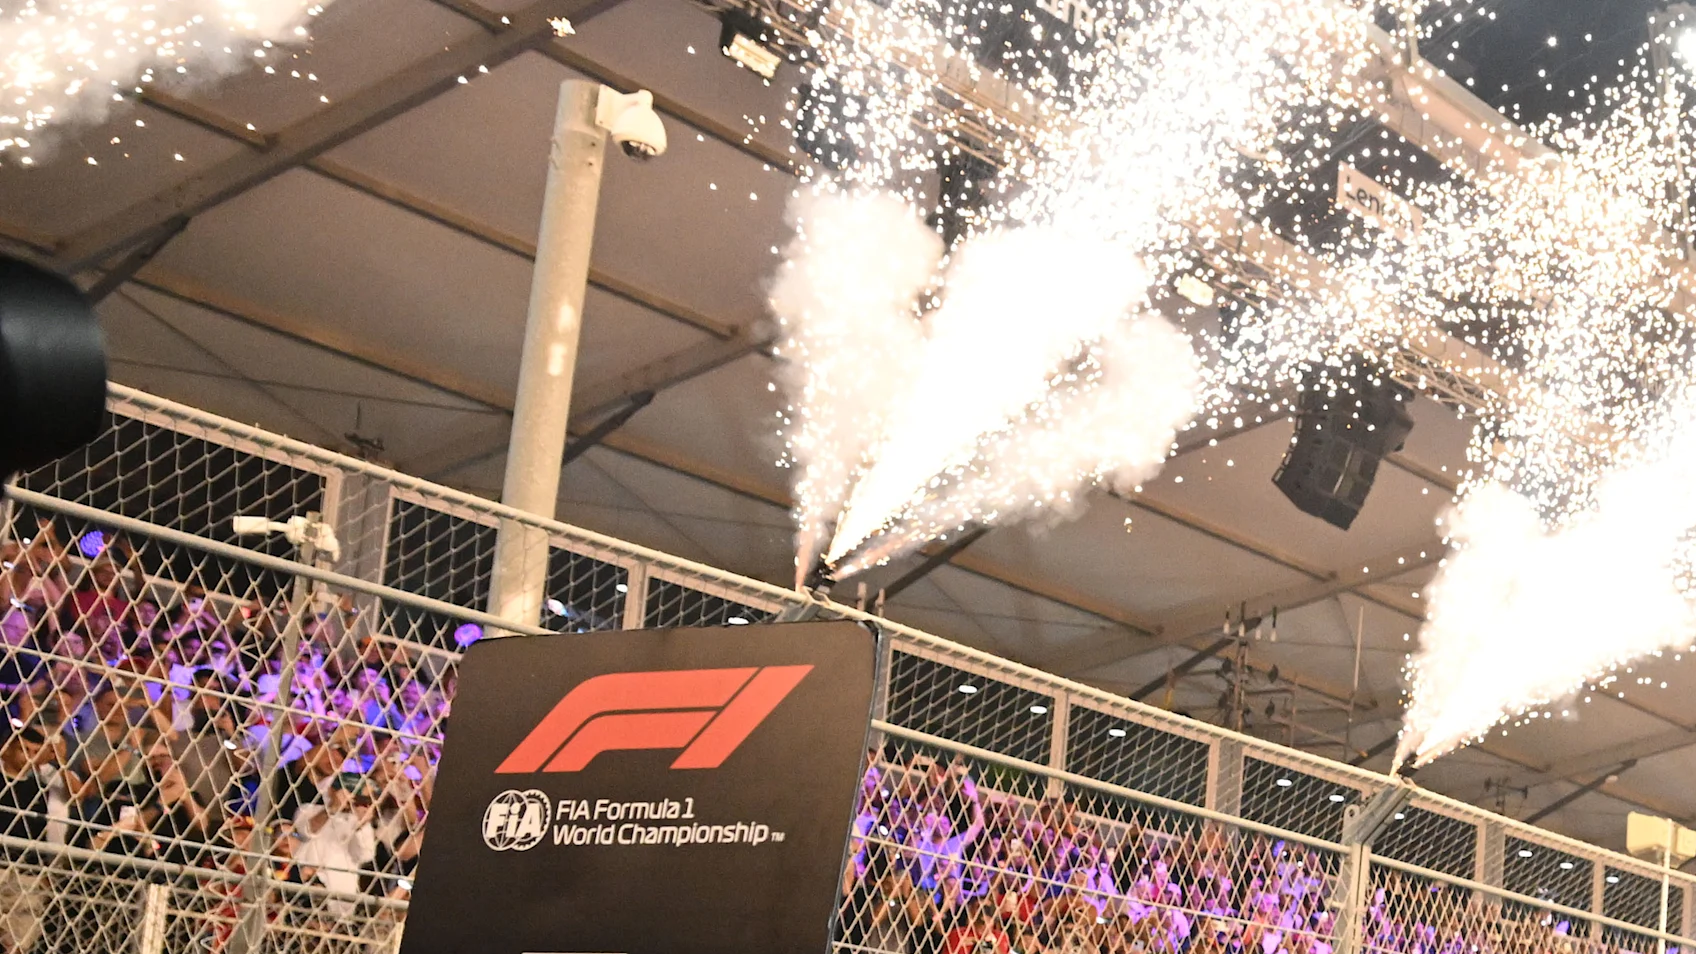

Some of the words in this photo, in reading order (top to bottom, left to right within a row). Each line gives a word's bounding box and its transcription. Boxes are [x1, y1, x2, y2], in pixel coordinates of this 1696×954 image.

[556, 800, 592, 821] FIA
[594, 798, 680, 821] Formula
[681, 797, 695, 819] 1
[553, 824, 615, 846] World
[617, 821, 769, 847] Championship
